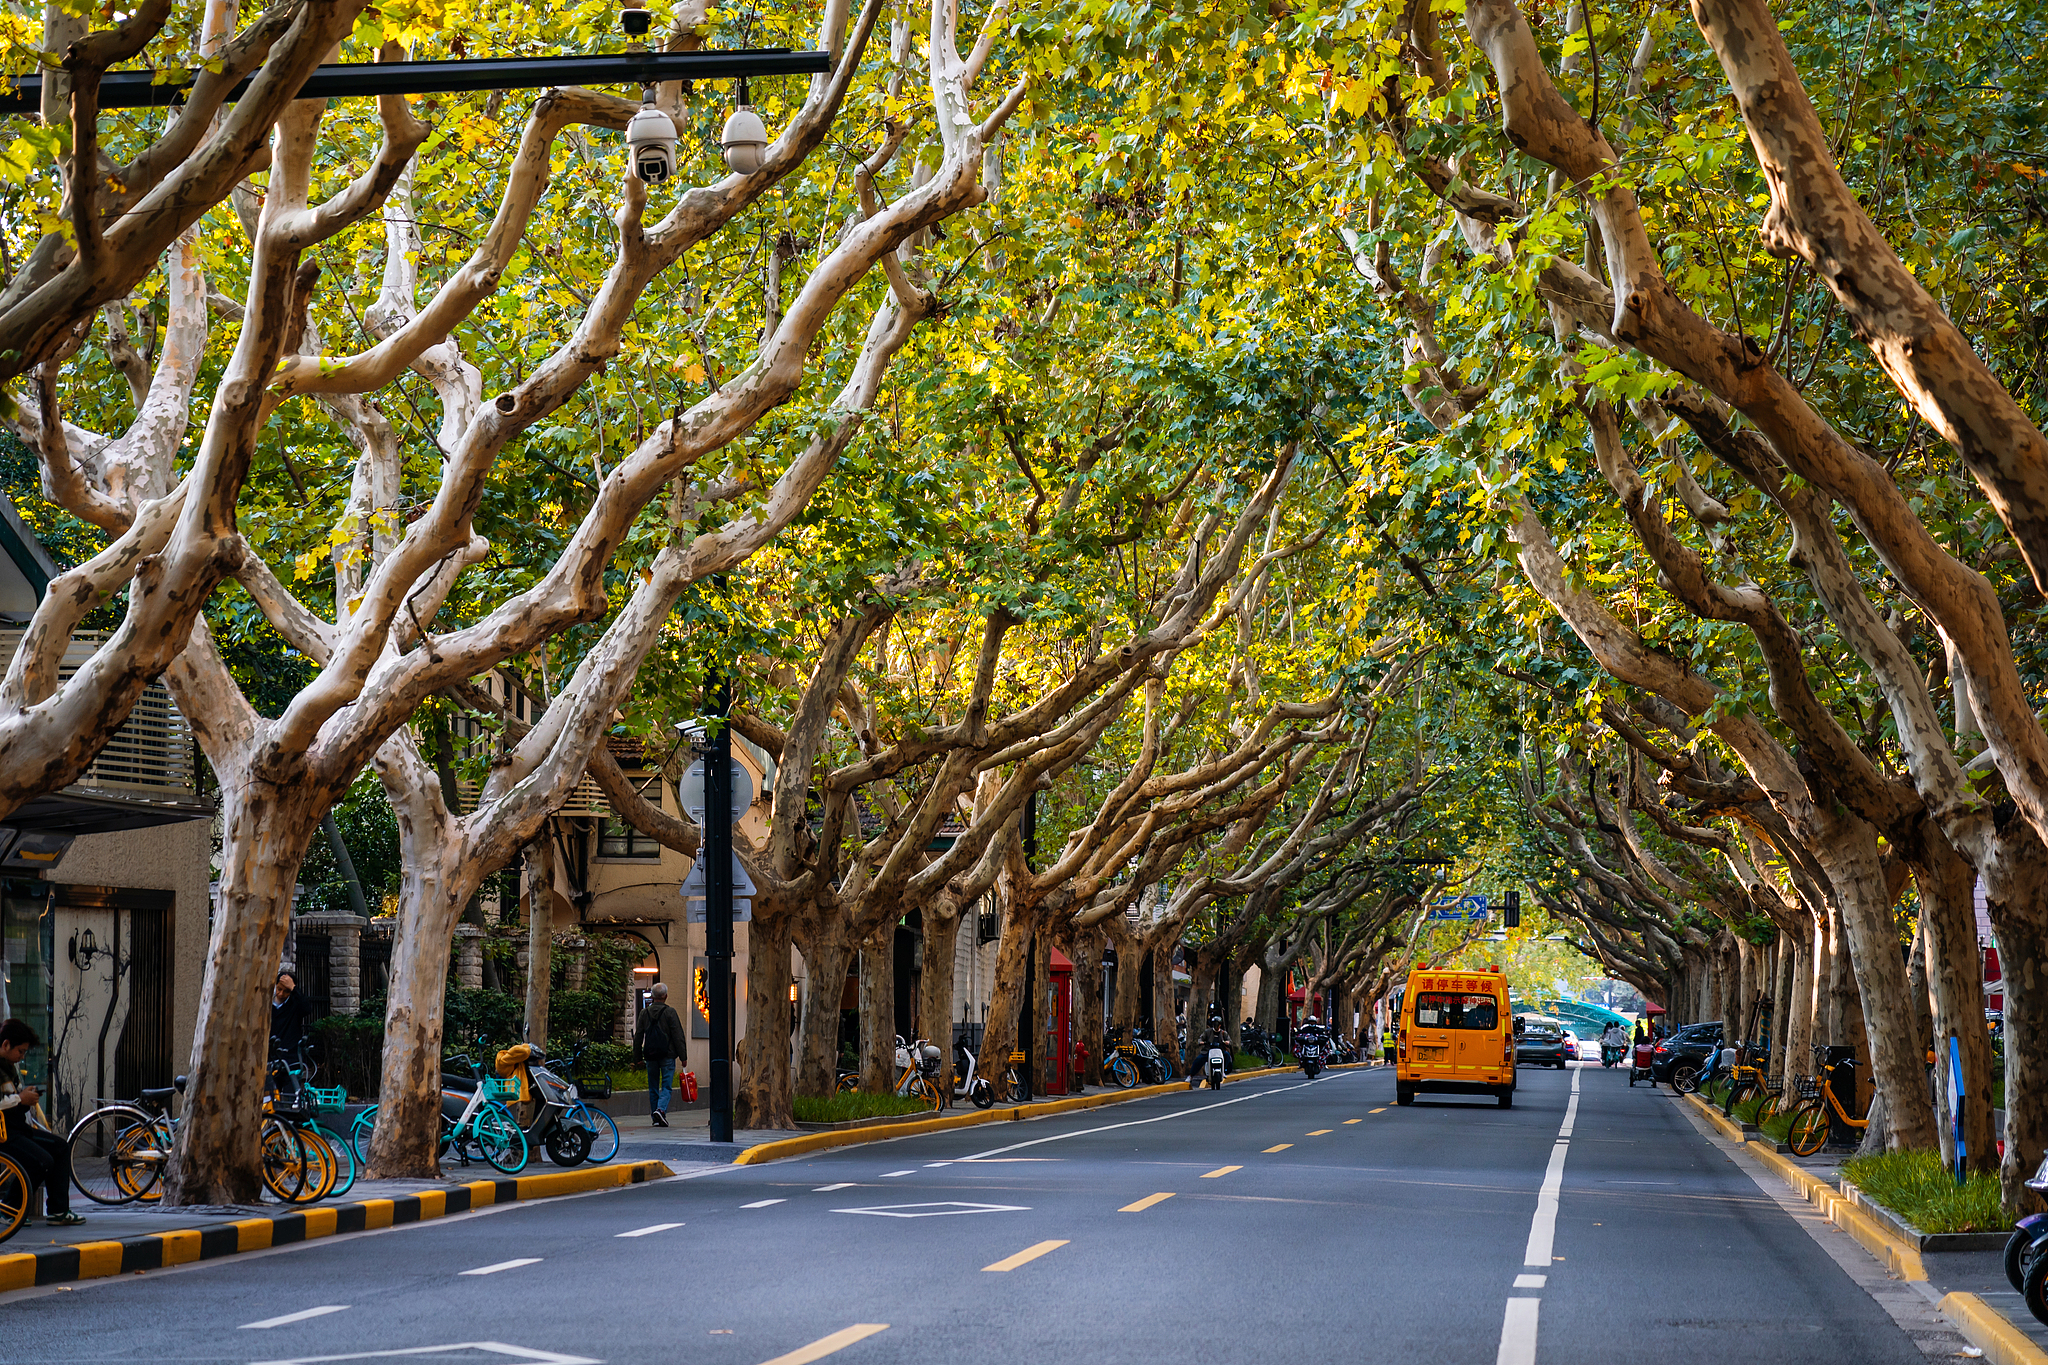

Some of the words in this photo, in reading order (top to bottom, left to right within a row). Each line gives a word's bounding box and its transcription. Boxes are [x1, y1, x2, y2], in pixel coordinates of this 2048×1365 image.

[1422, 979, 1493, 993] 请停车等候
